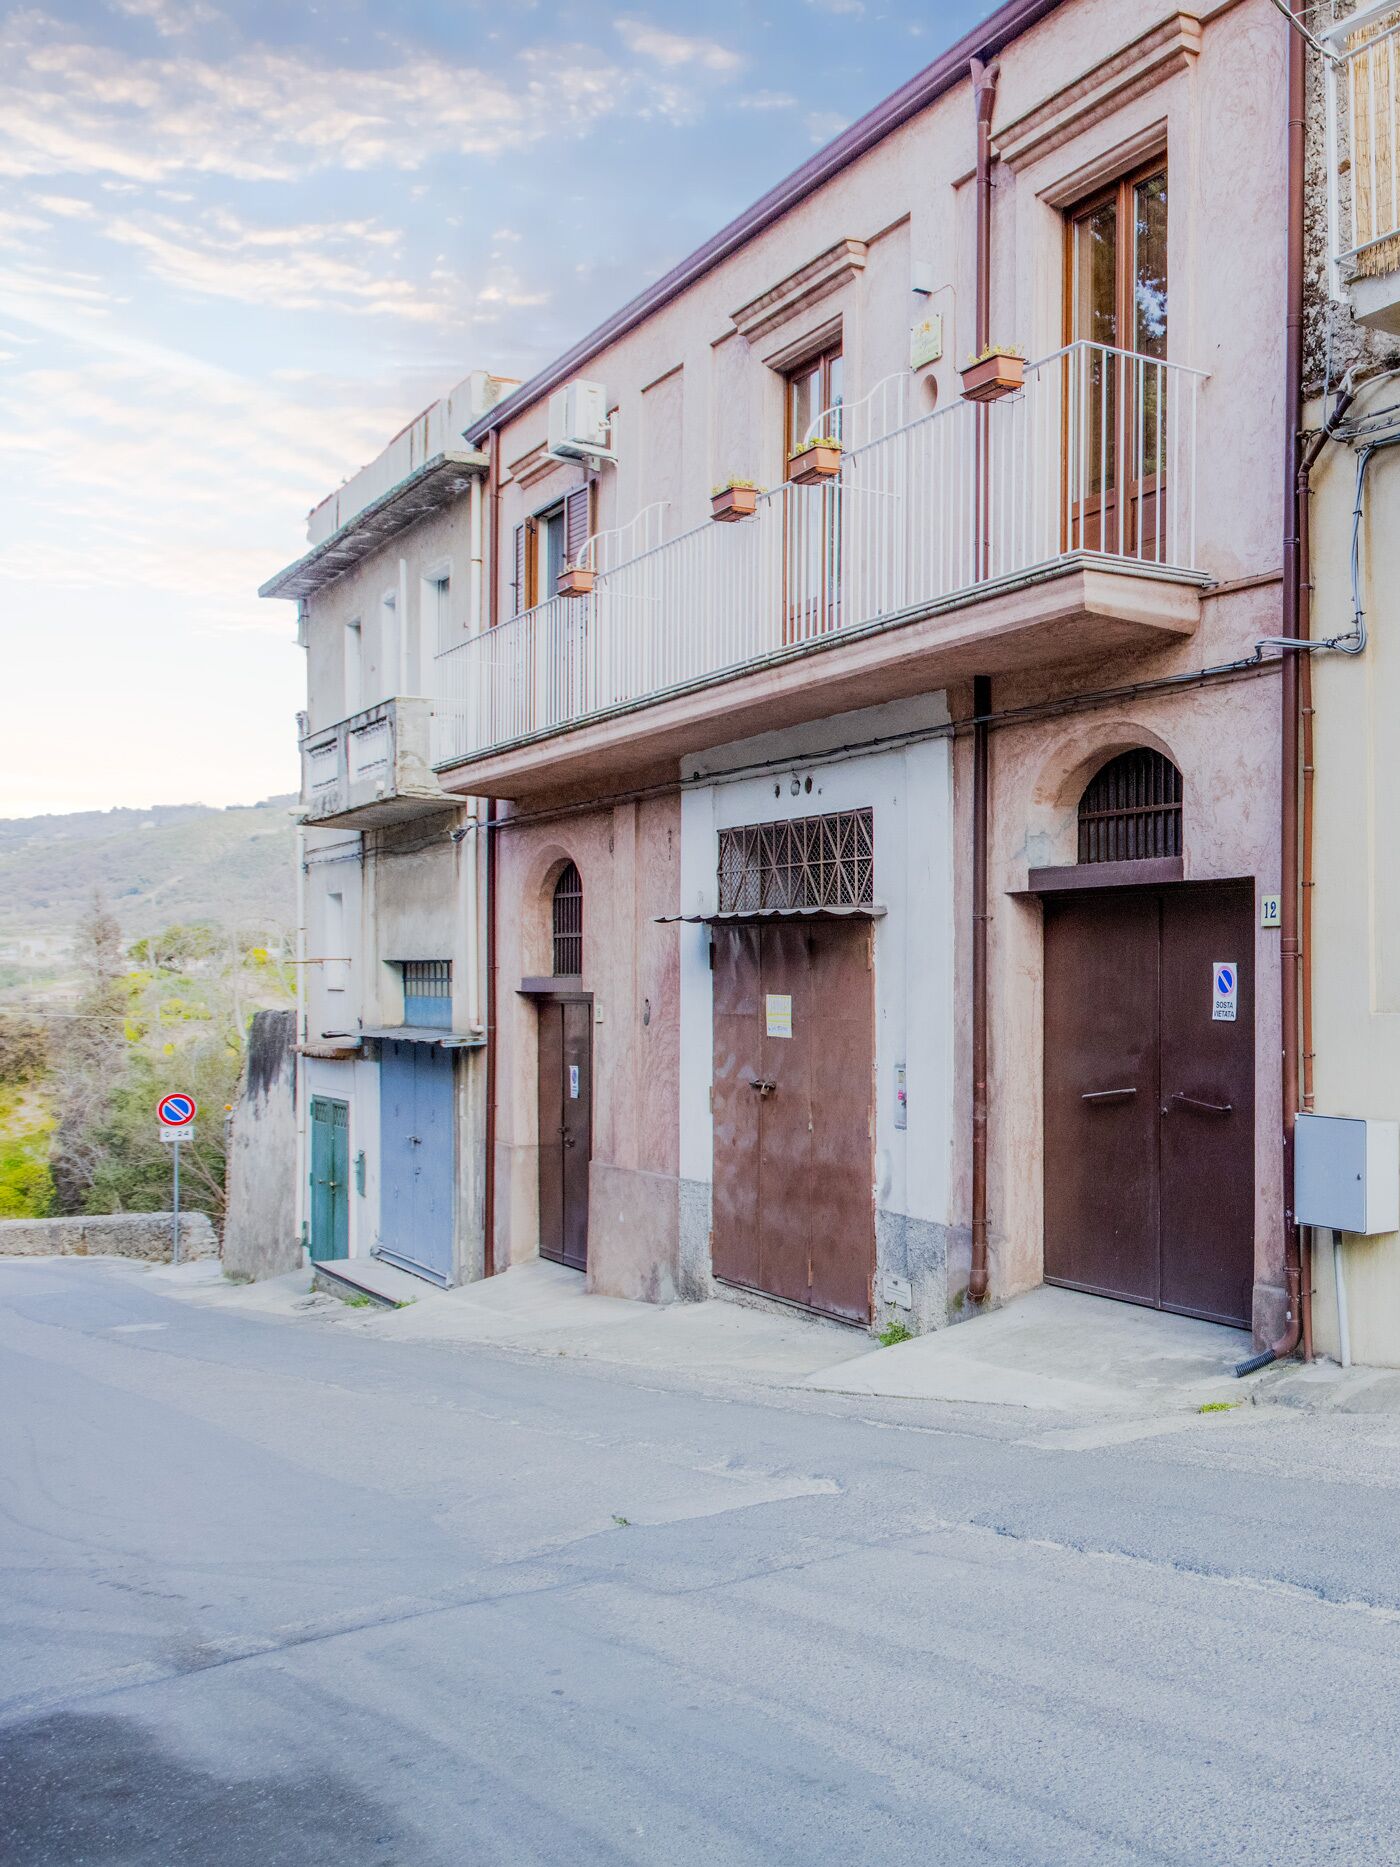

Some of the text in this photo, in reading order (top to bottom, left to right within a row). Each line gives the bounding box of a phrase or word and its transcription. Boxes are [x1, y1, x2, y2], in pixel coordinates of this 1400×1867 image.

[1264, 901, 1277, 919] 12
[1215, 1001, 1234, 1009] SOSTA
[1213, 1010, 1235, 1019] VIETATA
